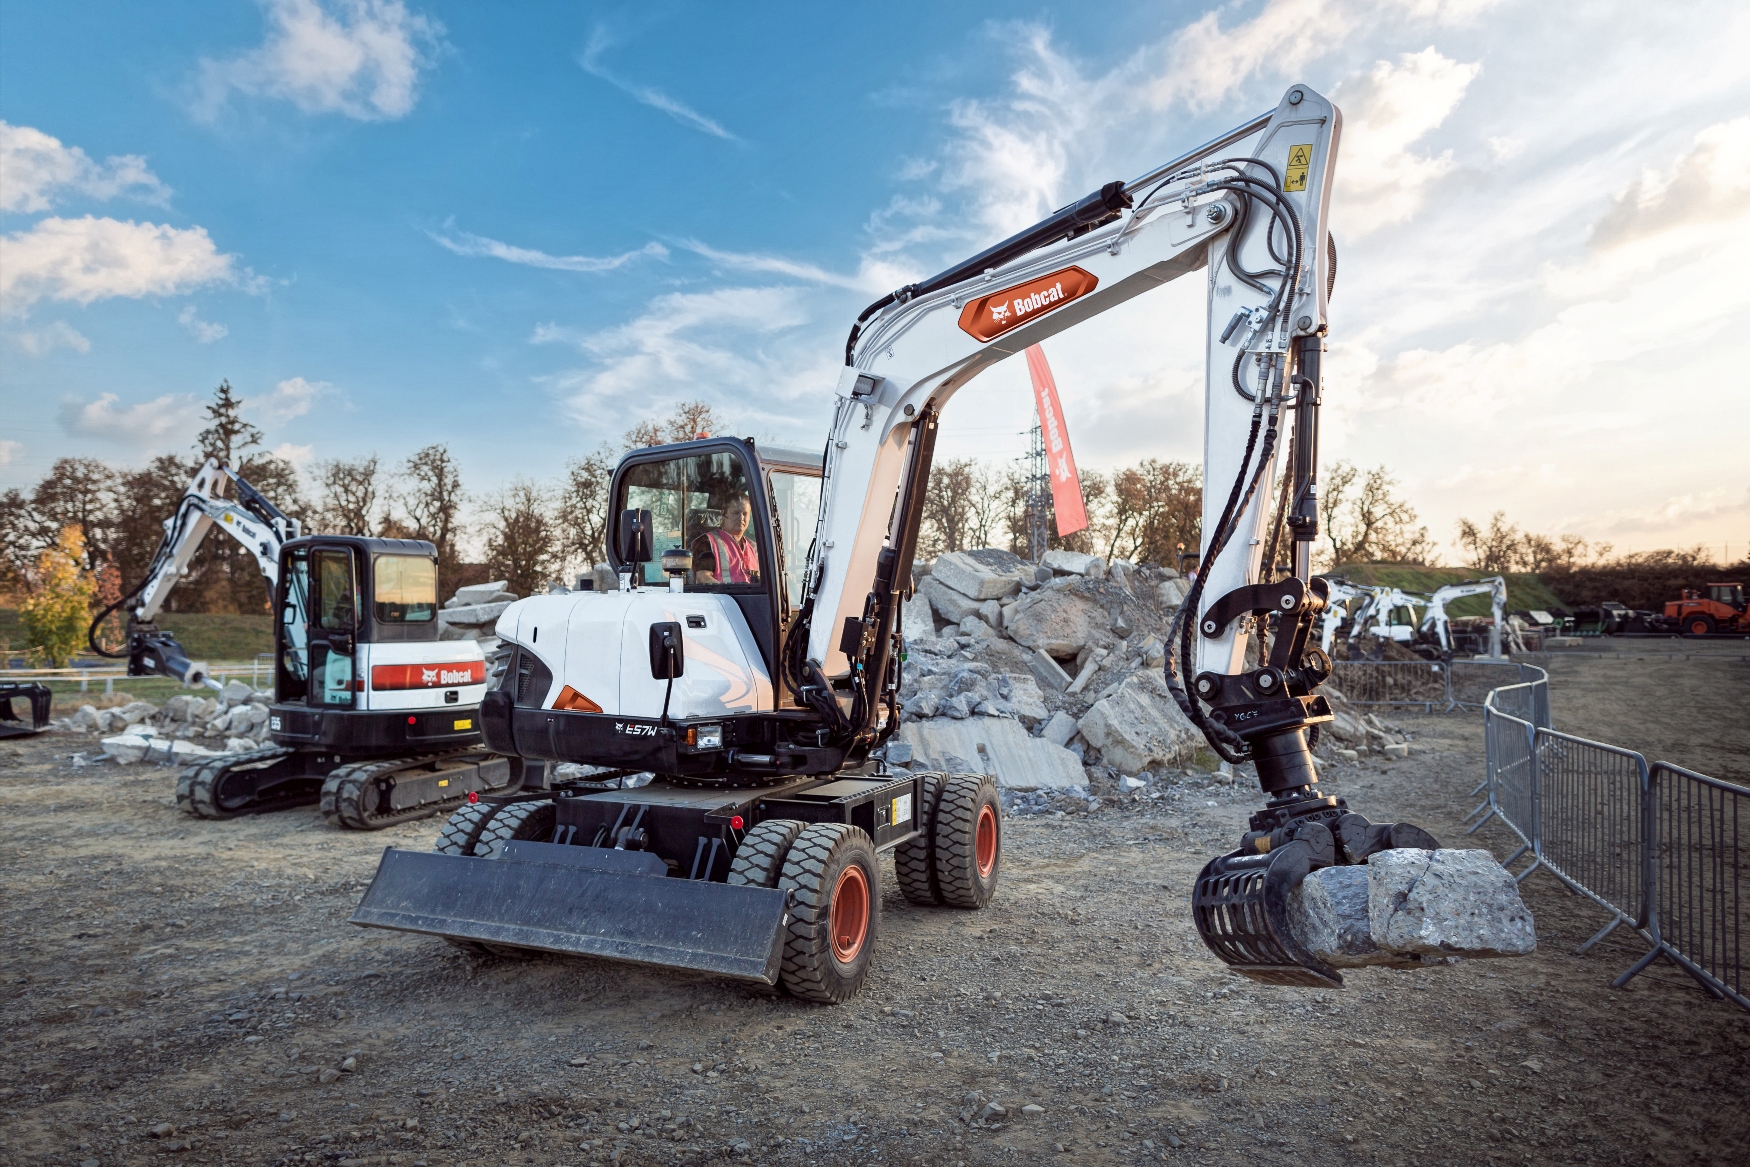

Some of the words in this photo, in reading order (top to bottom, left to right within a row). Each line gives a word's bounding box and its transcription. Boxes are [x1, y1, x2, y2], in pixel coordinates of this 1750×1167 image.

[1013, 281, 1065, 317] Bobcat
[440, 669, 472, 684] Bobcat
[625, 723, 657, 737] E57W
